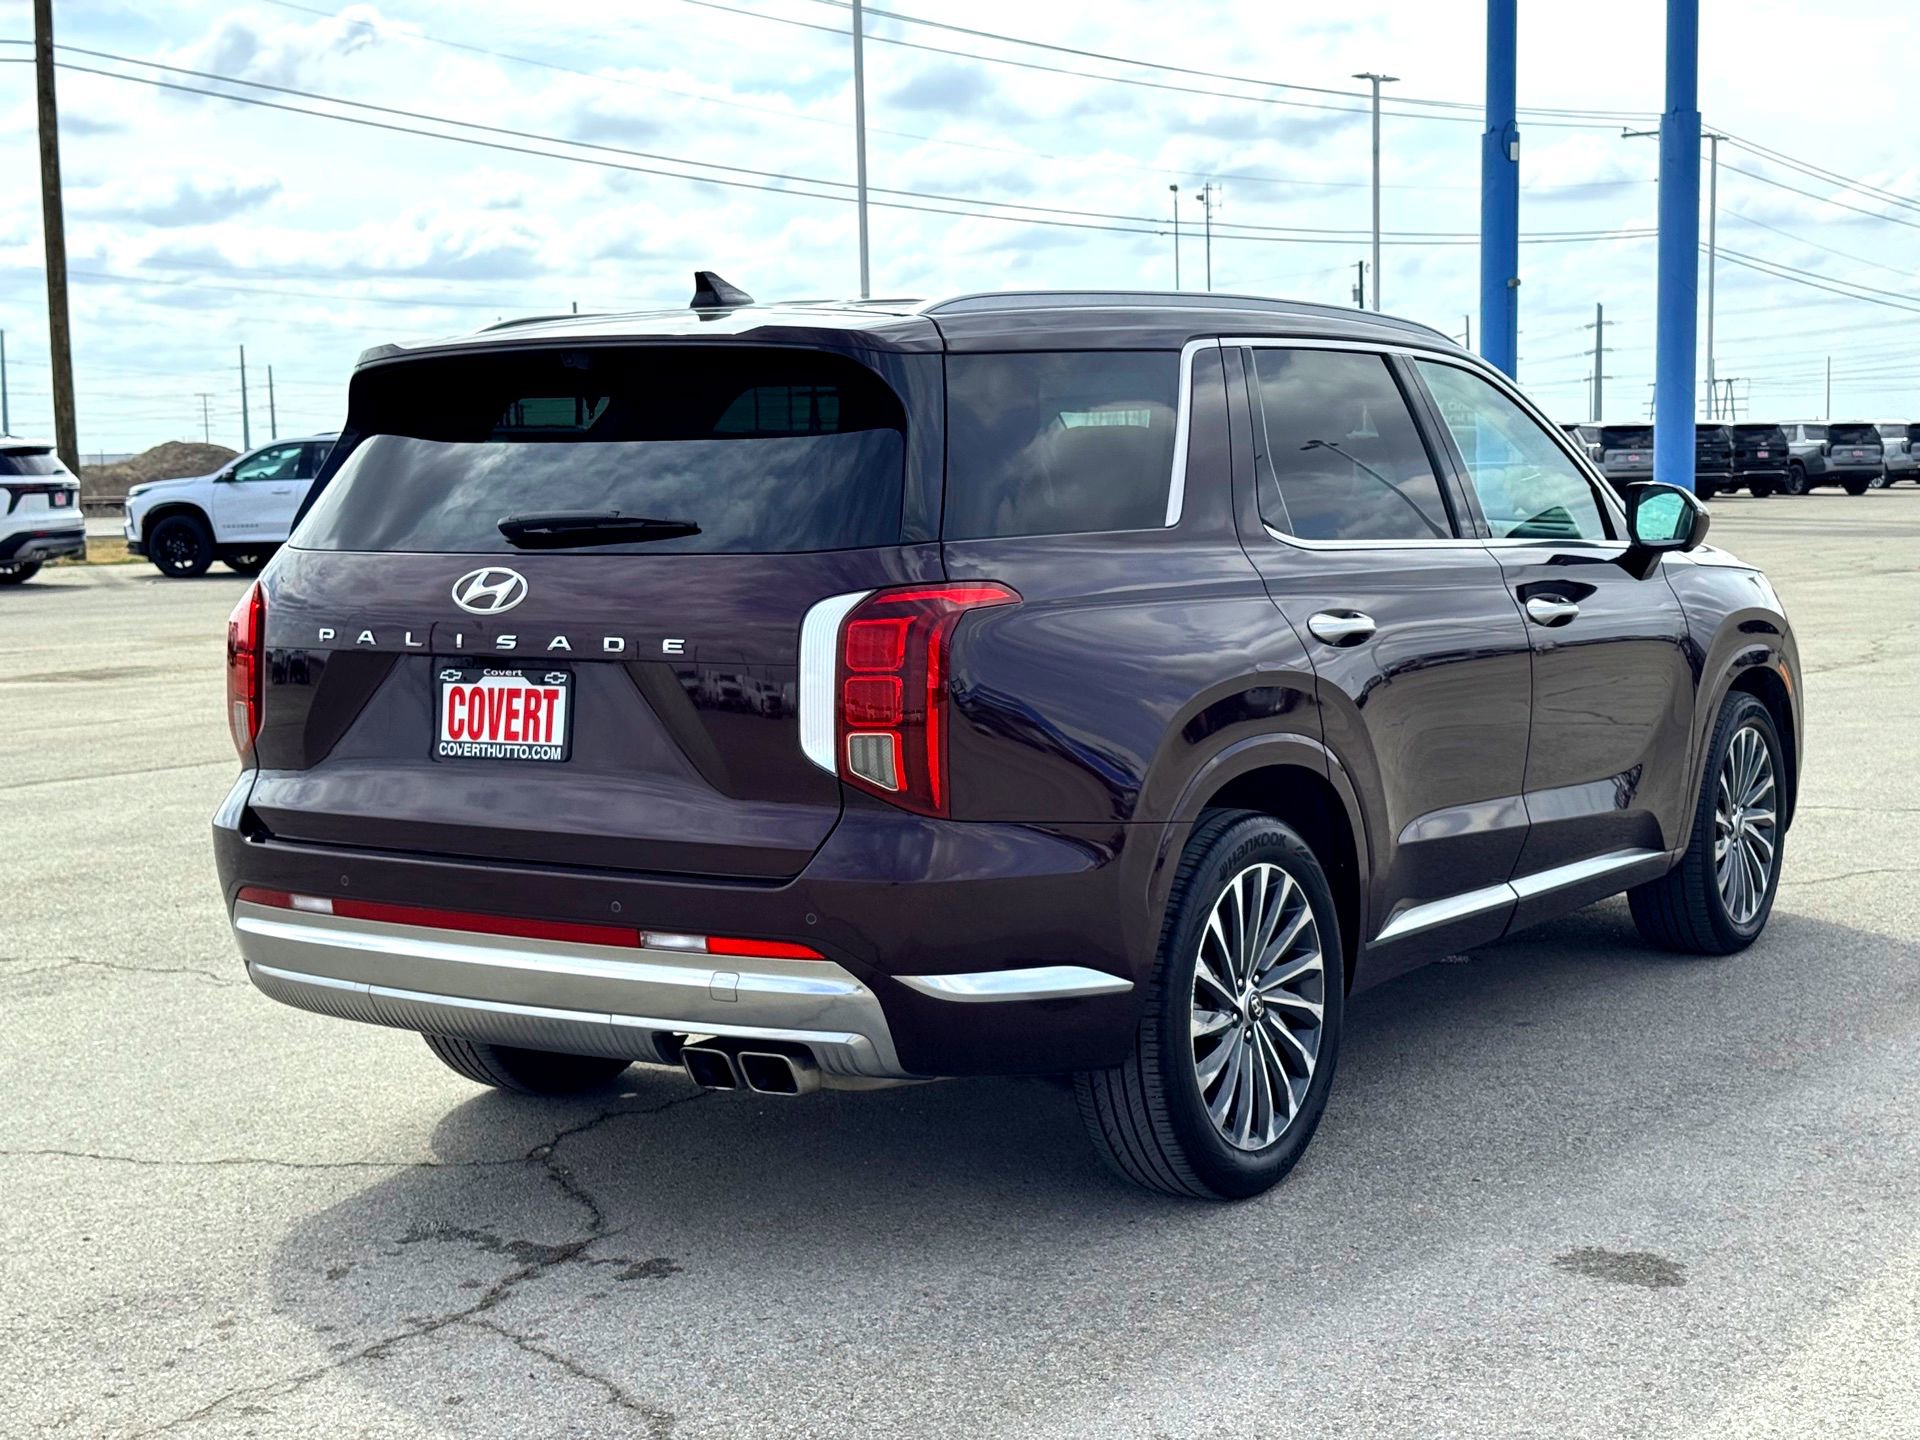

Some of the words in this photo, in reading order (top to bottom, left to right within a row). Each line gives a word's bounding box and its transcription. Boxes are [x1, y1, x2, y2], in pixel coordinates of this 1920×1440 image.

[318, 627, 686, 655] PALISADE
[482, 668, 523, 677] Covert
[448, 685, 560, 743] COVERT
[439, 741, 562, 761] COVERTHUTTO.COM
